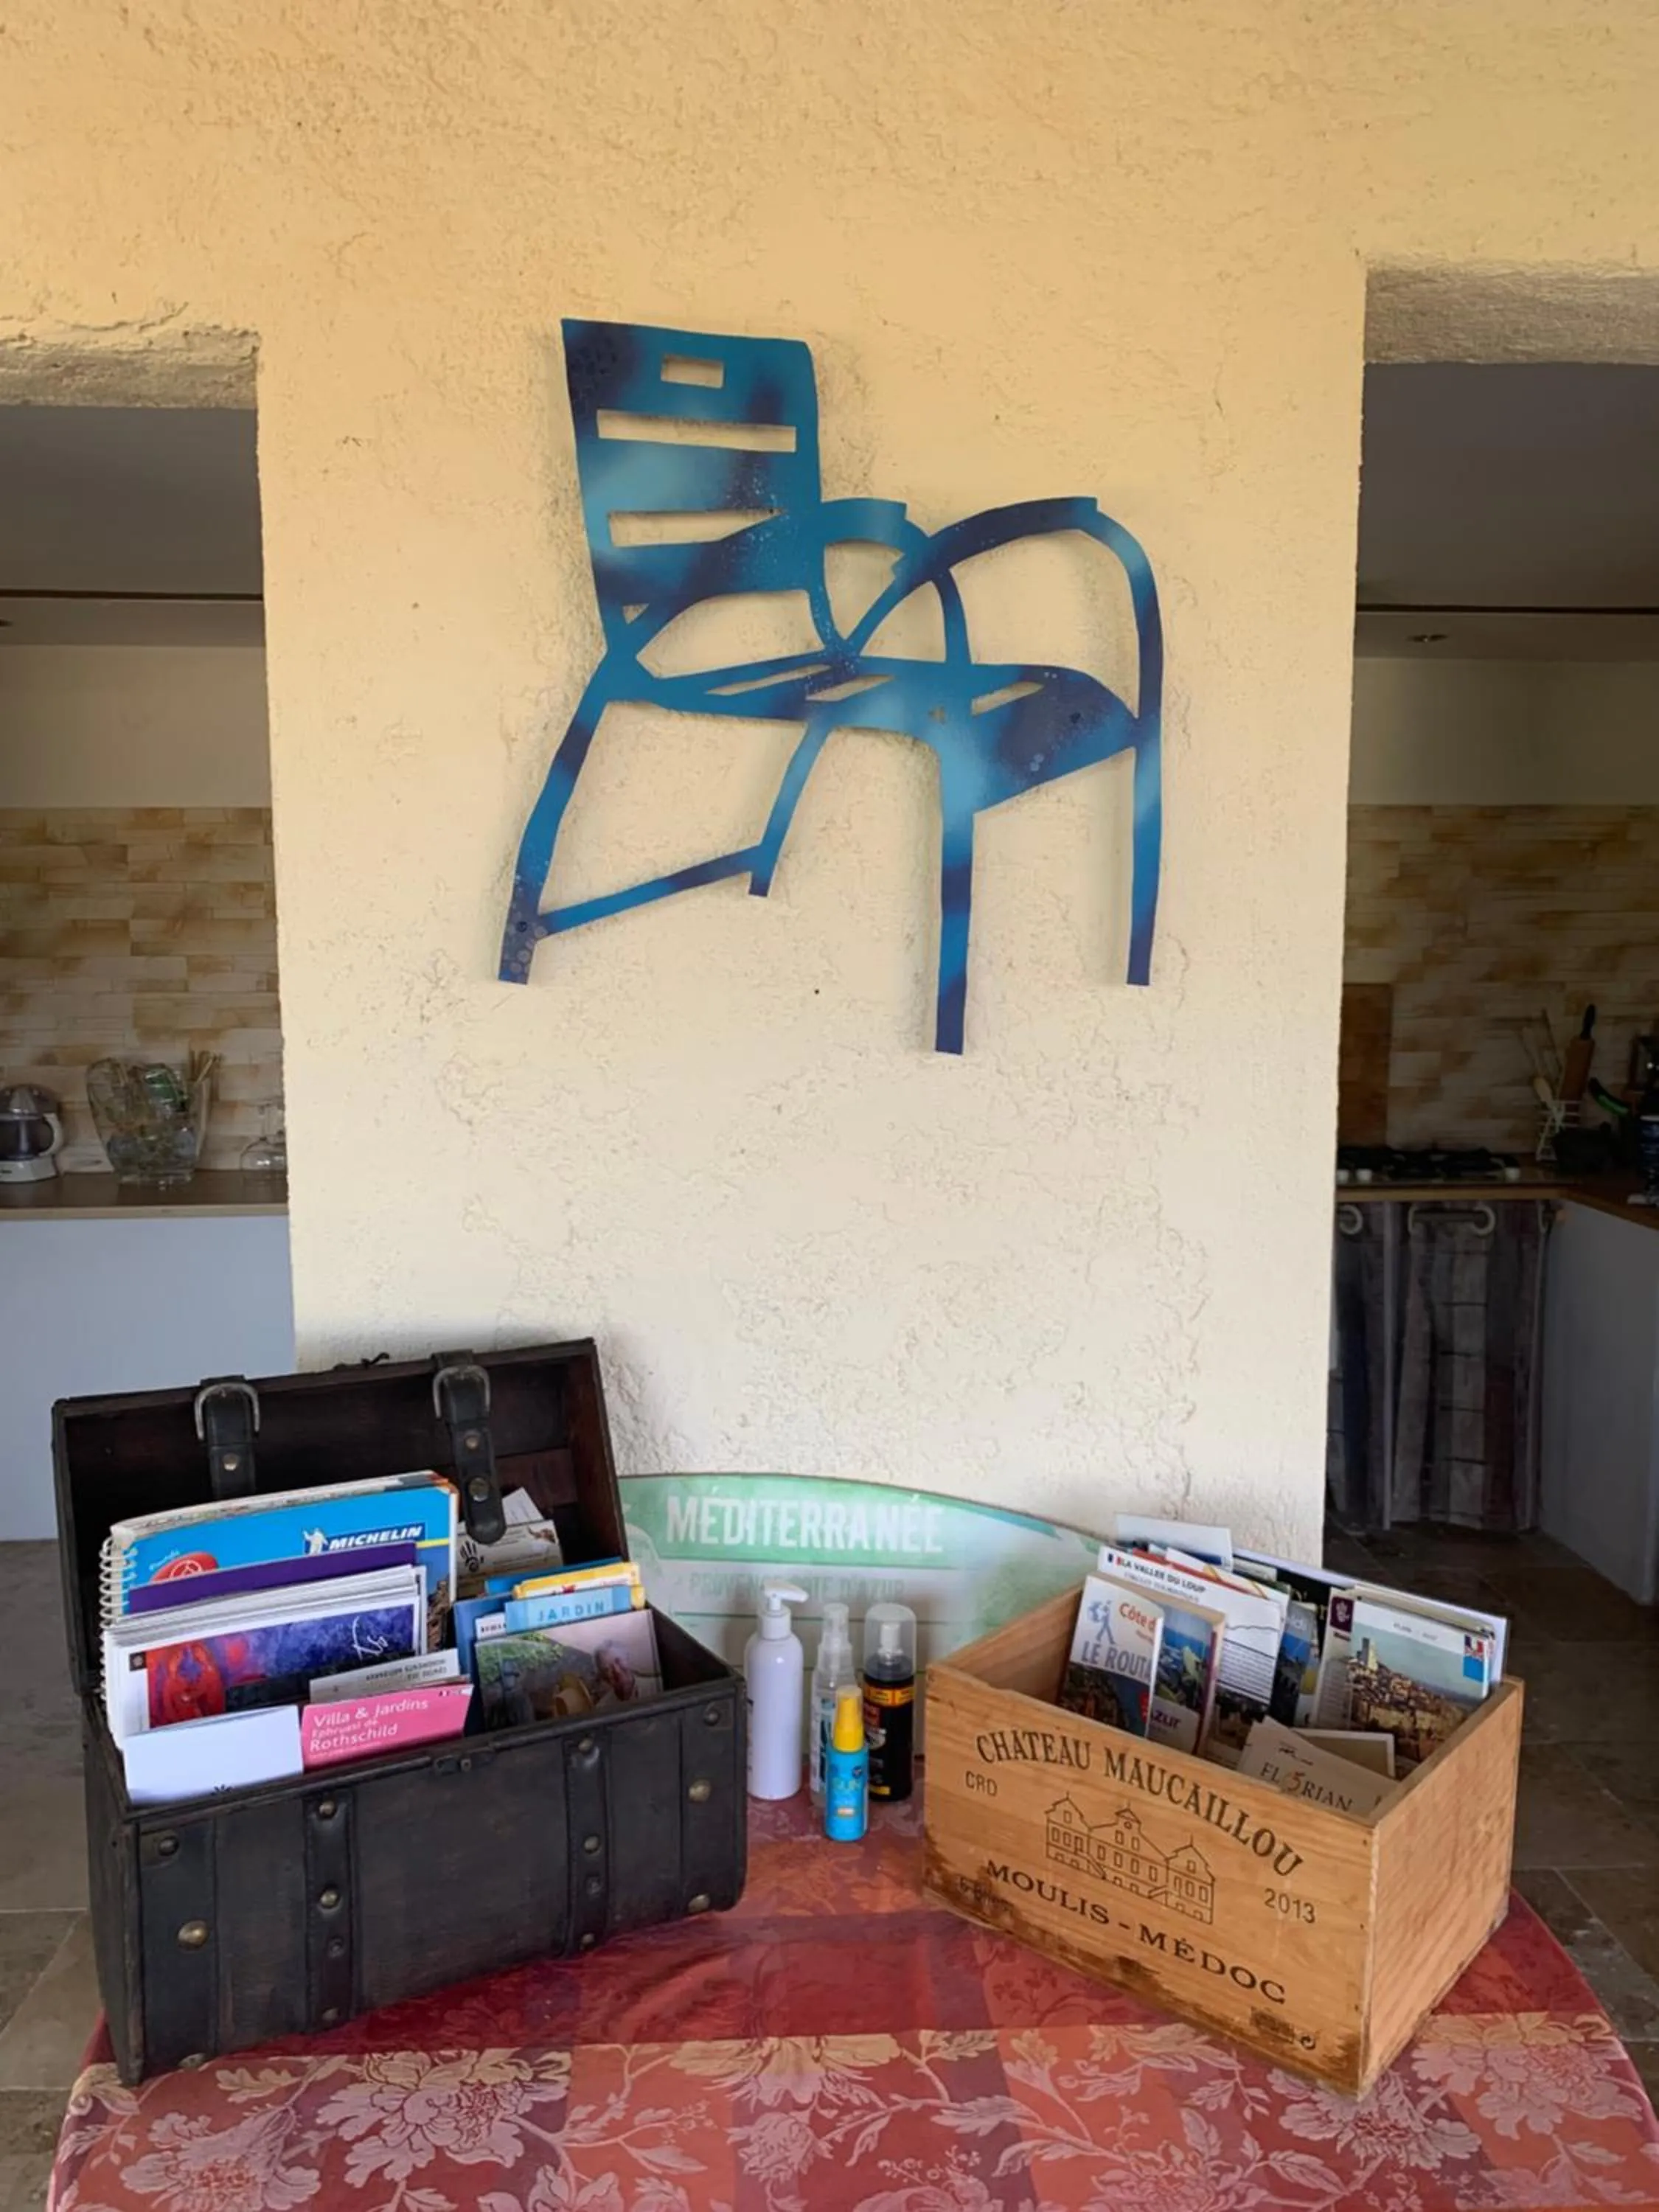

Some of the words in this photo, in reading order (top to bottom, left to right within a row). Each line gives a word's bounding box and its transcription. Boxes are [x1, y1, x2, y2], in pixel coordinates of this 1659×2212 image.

[667, 1486, 946, 1554] MÉDITERRANÉE
[329, 1526, 422, 1551] MICHELIN
[538, 1601, 605, 1621] JARDIN
[1081, 1641, 1102, 1665] LE
[313, 1711, 350, 1728] Villa
[355, 1707, 368, 1719] &
[374, 1698, 428, 1718] Jardins
[1152, 1710, 1181, 1729] zur
[310, 1724, 398, 1753] Rothschild
[965, 1770, 998, 1796] CRD
[1104, 1747, 1304, 1877] MAUCAILLOU
[987, 1860, 1110, 1924] MOULIS
[1265, 1888, 1315, 1924] 2013
